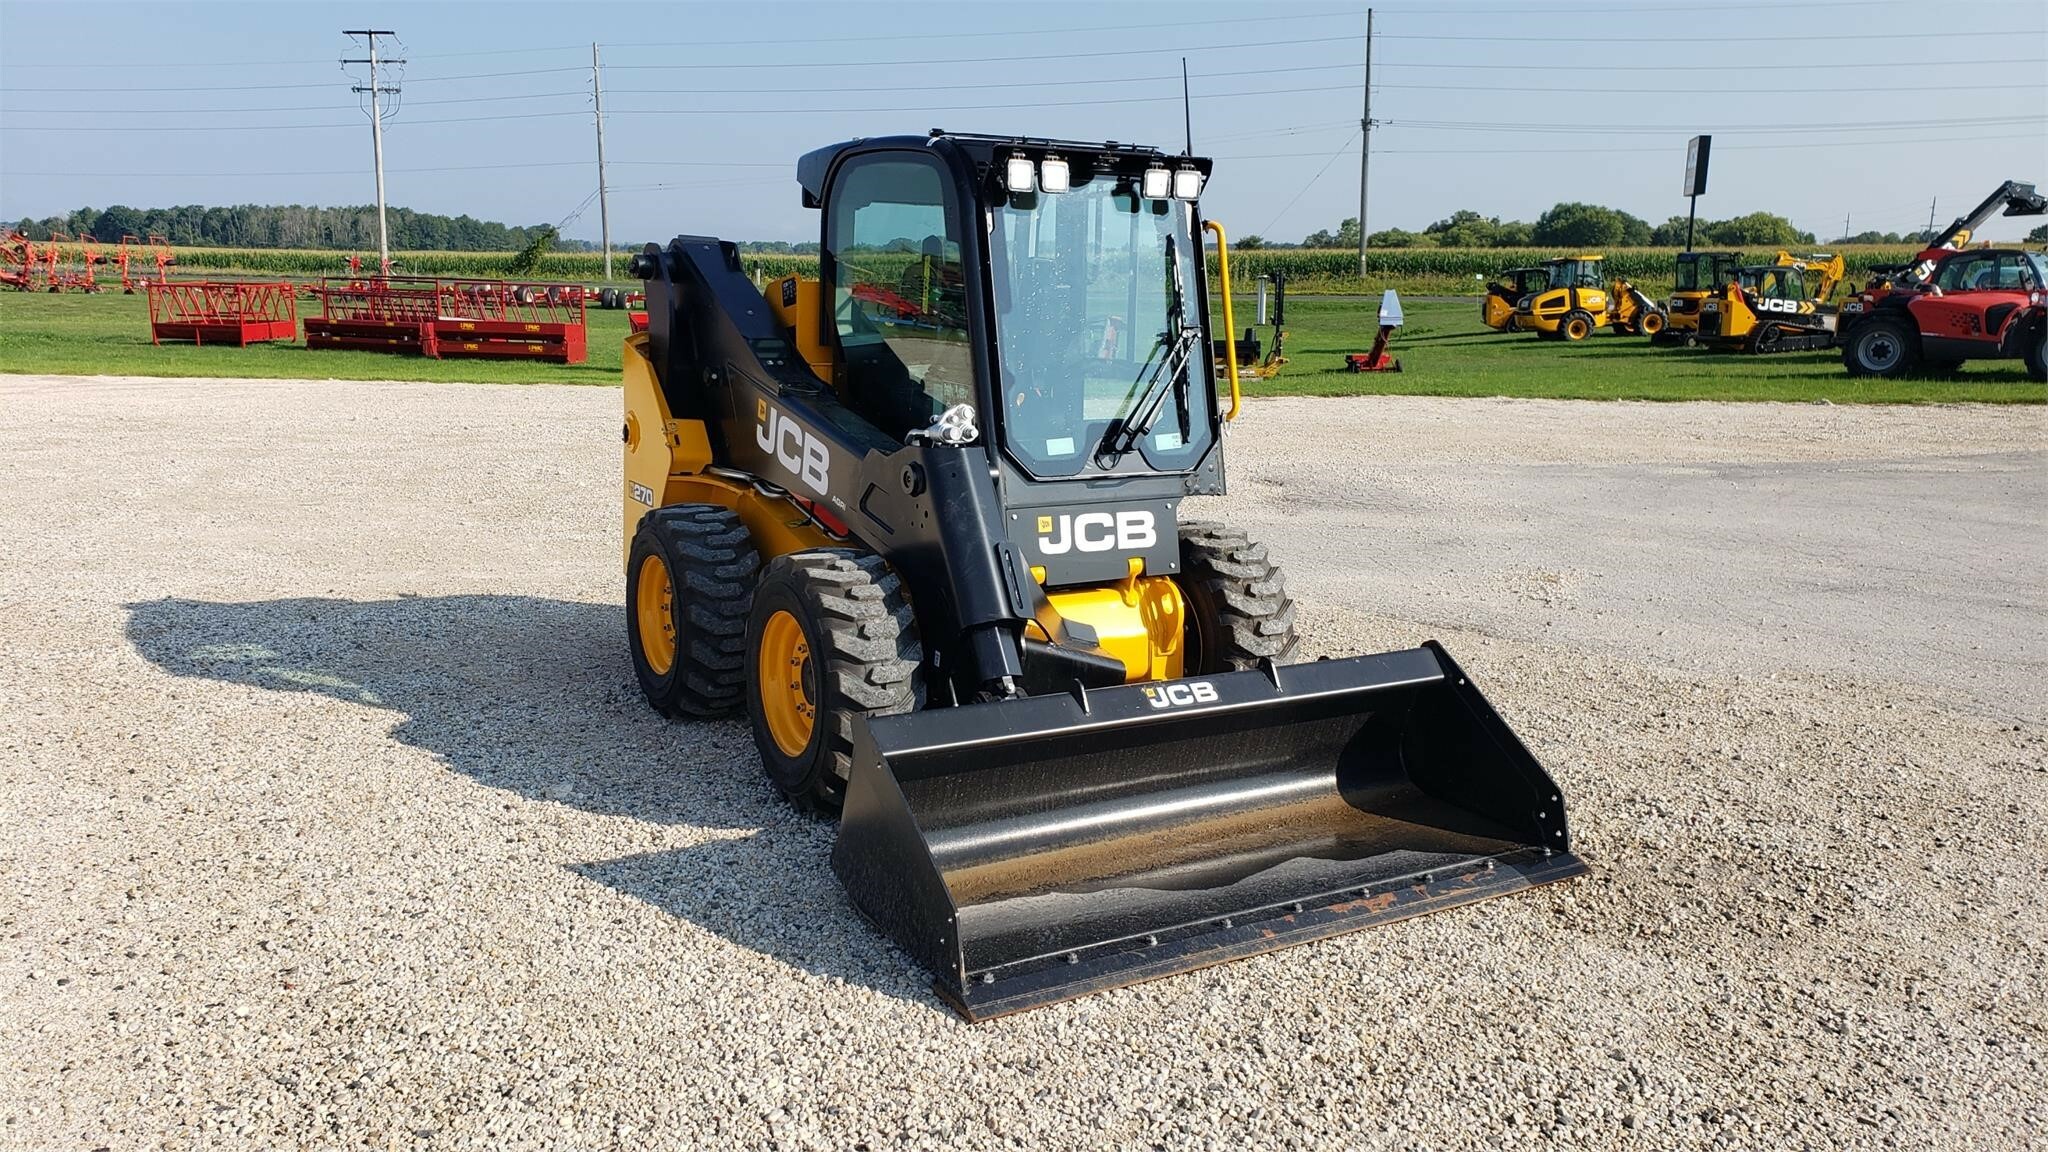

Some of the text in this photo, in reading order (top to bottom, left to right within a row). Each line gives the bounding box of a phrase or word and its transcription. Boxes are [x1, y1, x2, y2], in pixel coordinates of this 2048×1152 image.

[1704, 303, 1718, 311] JCB
[1758, 298, 1797, 313] JCB
[1843, 302, 1864, 312] JCB
[757, 406, 830, 496] JCB
[634, 483, 653, 506] 270
[1038, 511, 1157, 555] JCB
[1149, 682, 1219, 708] JCB
